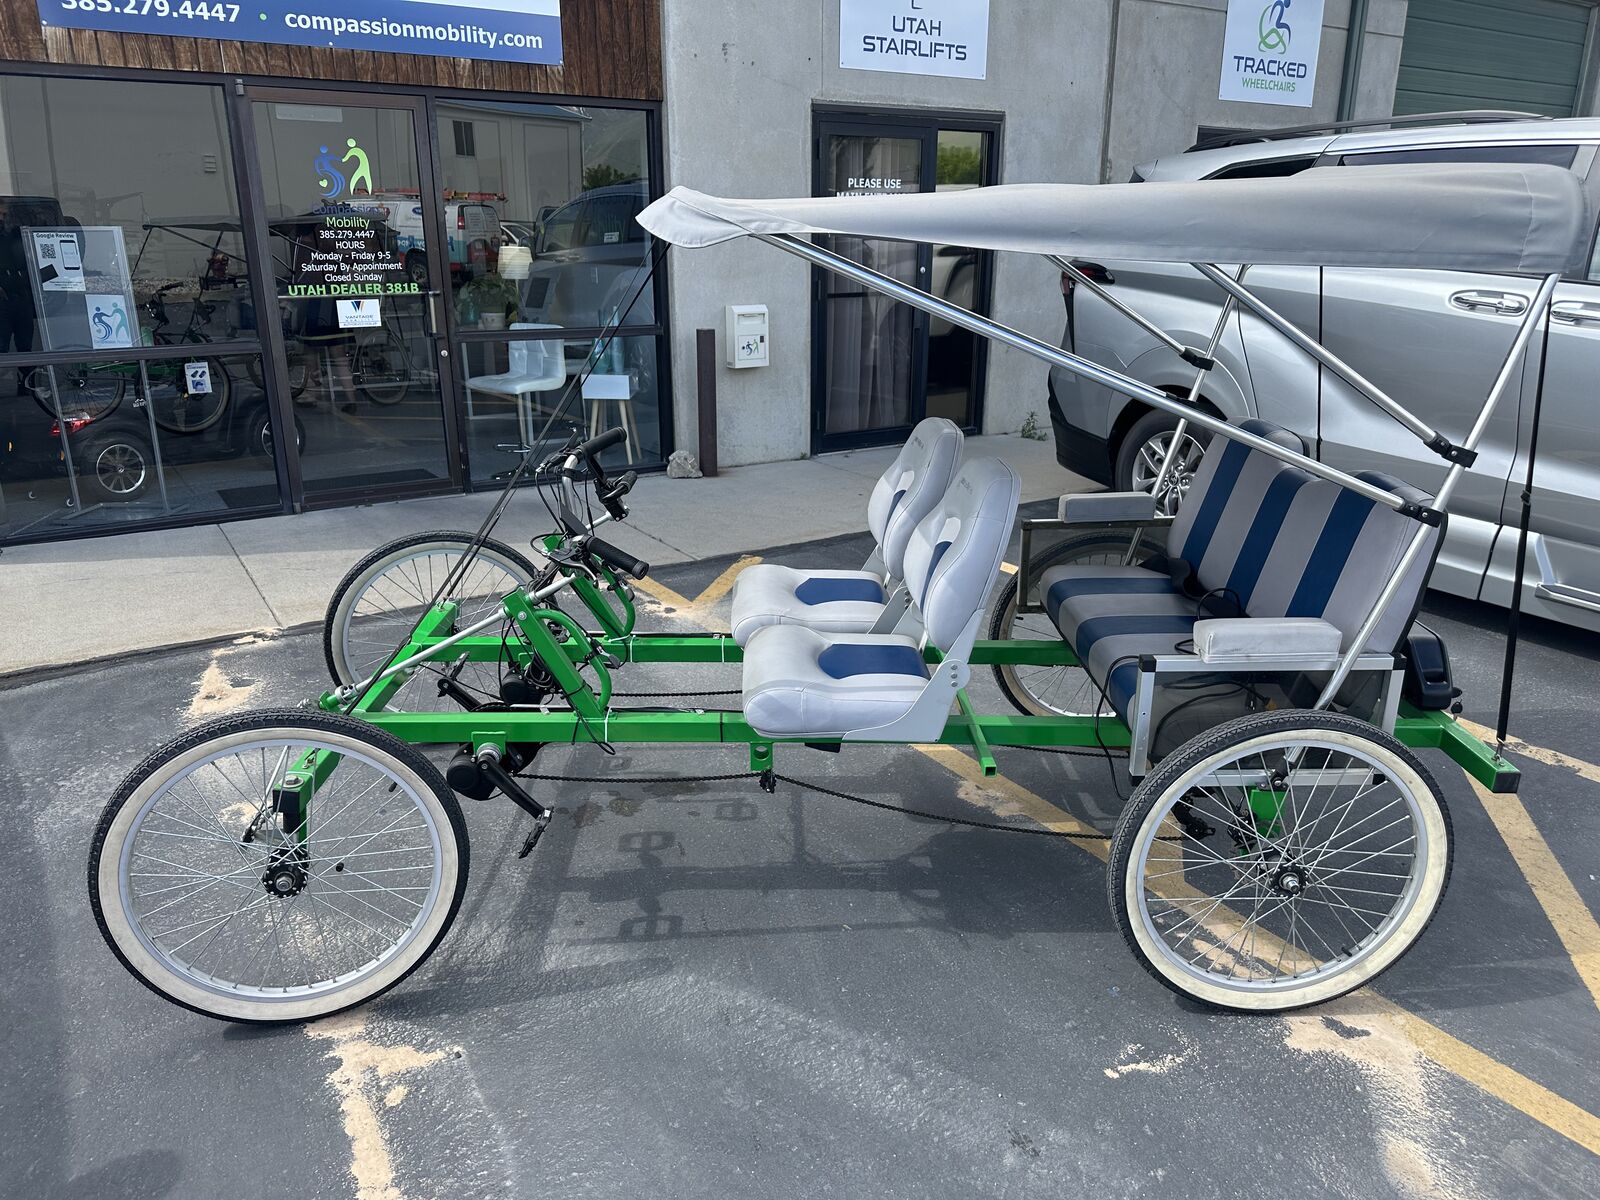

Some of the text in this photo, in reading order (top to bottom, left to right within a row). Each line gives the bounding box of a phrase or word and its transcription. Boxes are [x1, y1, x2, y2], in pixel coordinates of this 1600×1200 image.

[284, 12, 543, 49] compassionmobility.com
[892, 15, 942, 37] UTAH
[863, 35, 967, 61] STAIRLIFTS
[1233, 55, 1307, 79] TRACKED
[1241, 77, 1296, 93] WHEELCHAIRS
[848, 178, 902, 188] PLEASE USE
[326, 216, 370, 230] Mobility
[319, 230, 375, 239] 385.279.4447
[335, 241, 366, 249] HOURS
[311, 252, 343, 261] Monday
[351, 251, 375, 261] Friday
[377, 251, 391, 260] 9-5
[301, 262, 403, 273] Saturday By Appointment
[324, 273, 383, 282] Closed Sunday
[288, 282, 420, 296] UTAH DEALER 381B
